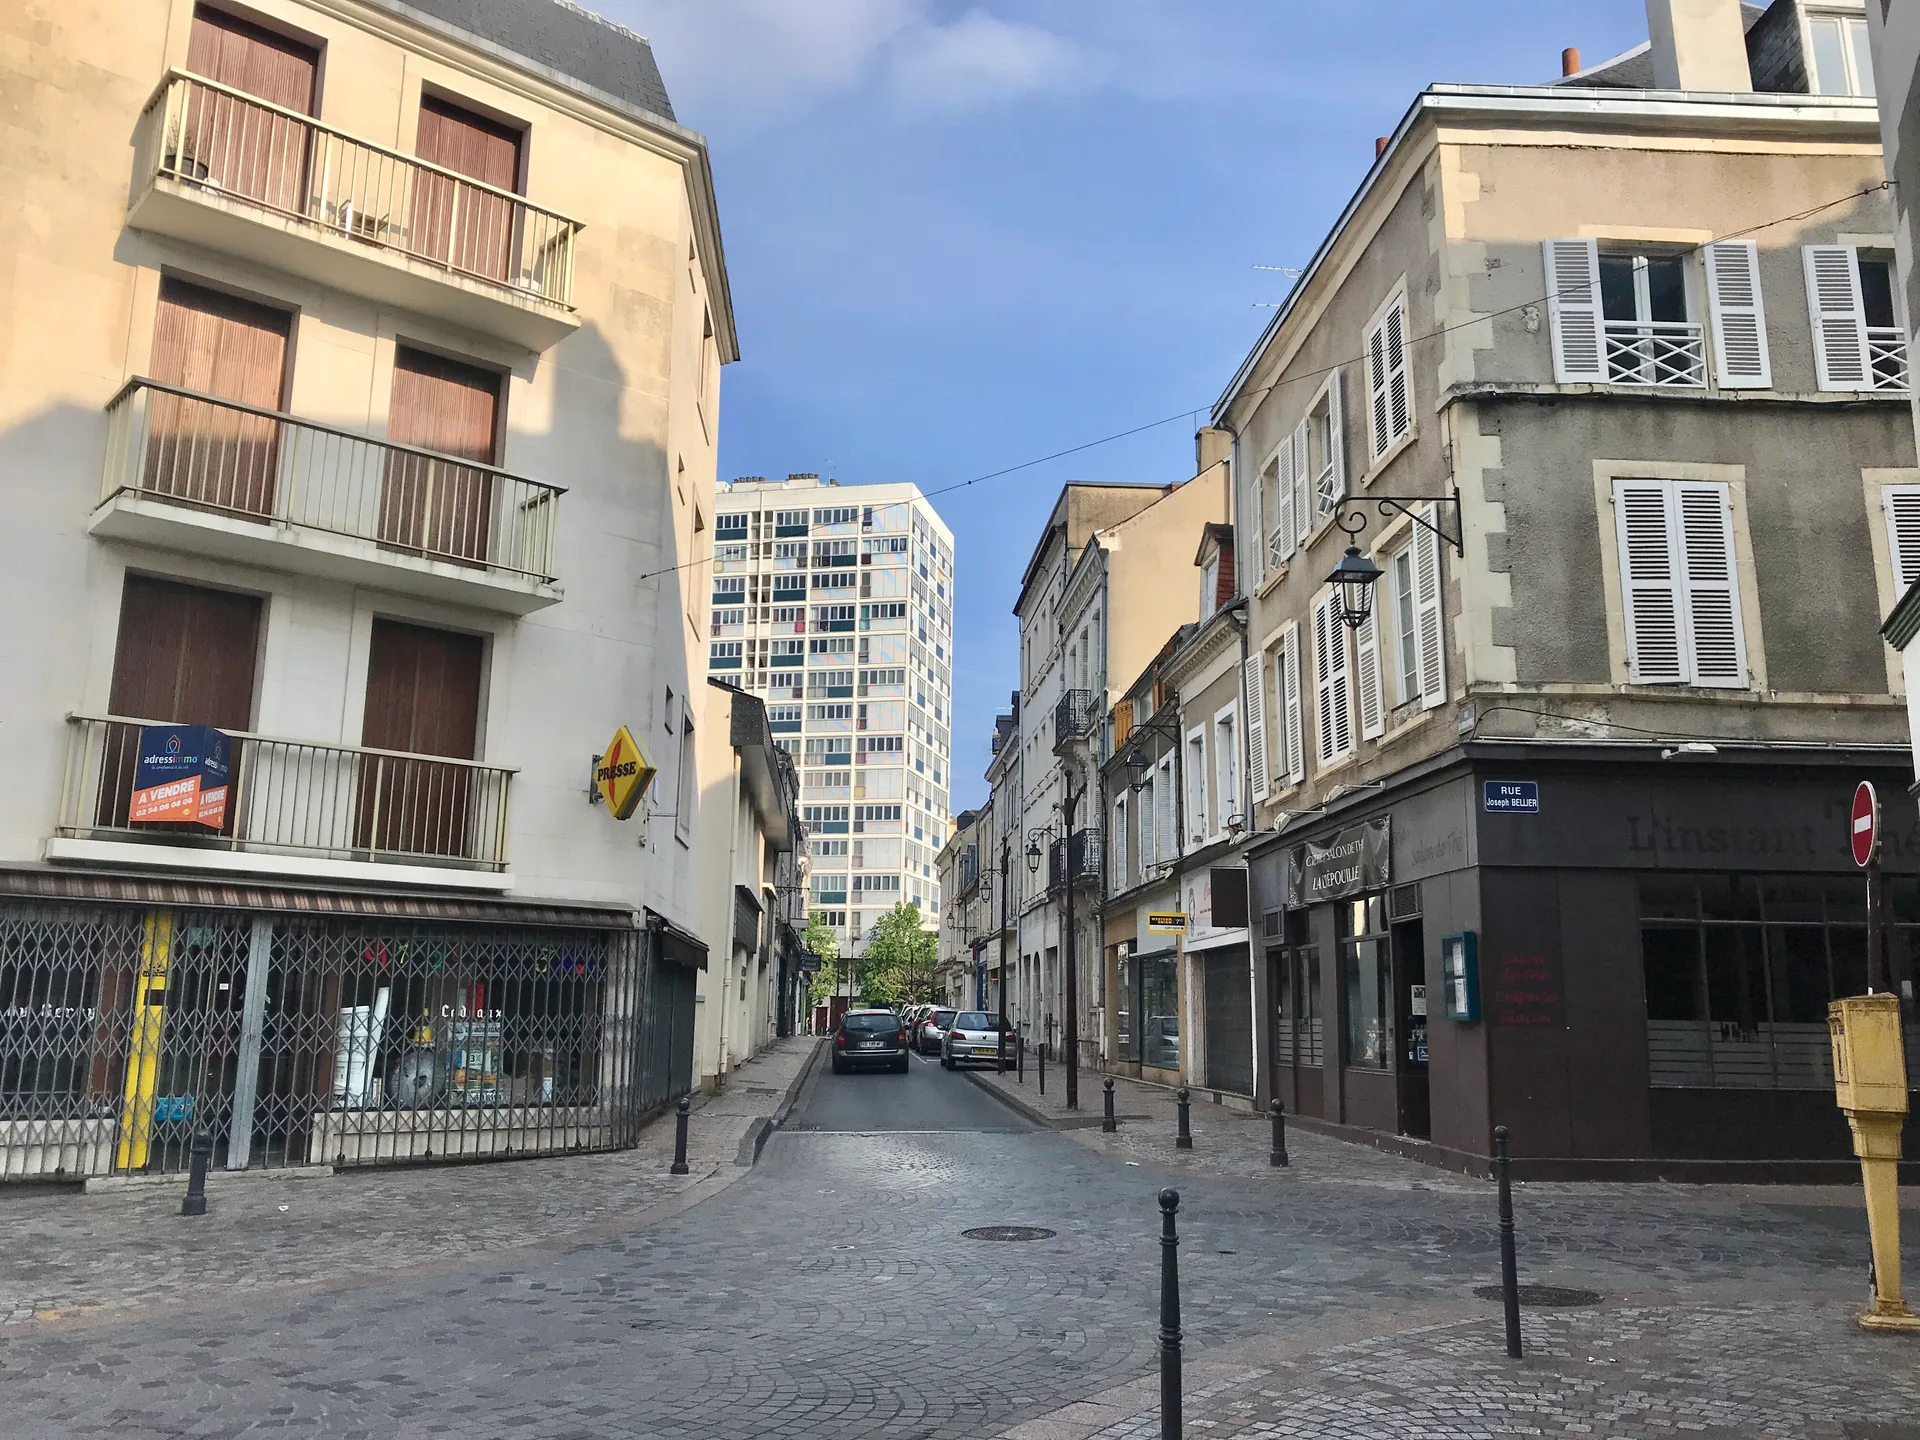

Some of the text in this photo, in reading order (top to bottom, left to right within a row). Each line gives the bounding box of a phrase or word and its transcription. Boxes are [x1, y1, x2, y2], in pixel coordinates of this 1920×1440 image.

[144, 755, 198, 764] adressimmo
[597, 761, 636, 781] PRESSE
[138, 792, 147, 804] A
[150, 780, 195, 801] VENDRE
[1501, 786, 1521, 795] RUE
[1487, 798, 1537, 807] Joseph BELLIER
[136, 809, 146, 817] 02
[148, 806, 158, 814] 54
[441, 1004, 502, 1018] Cadaux
